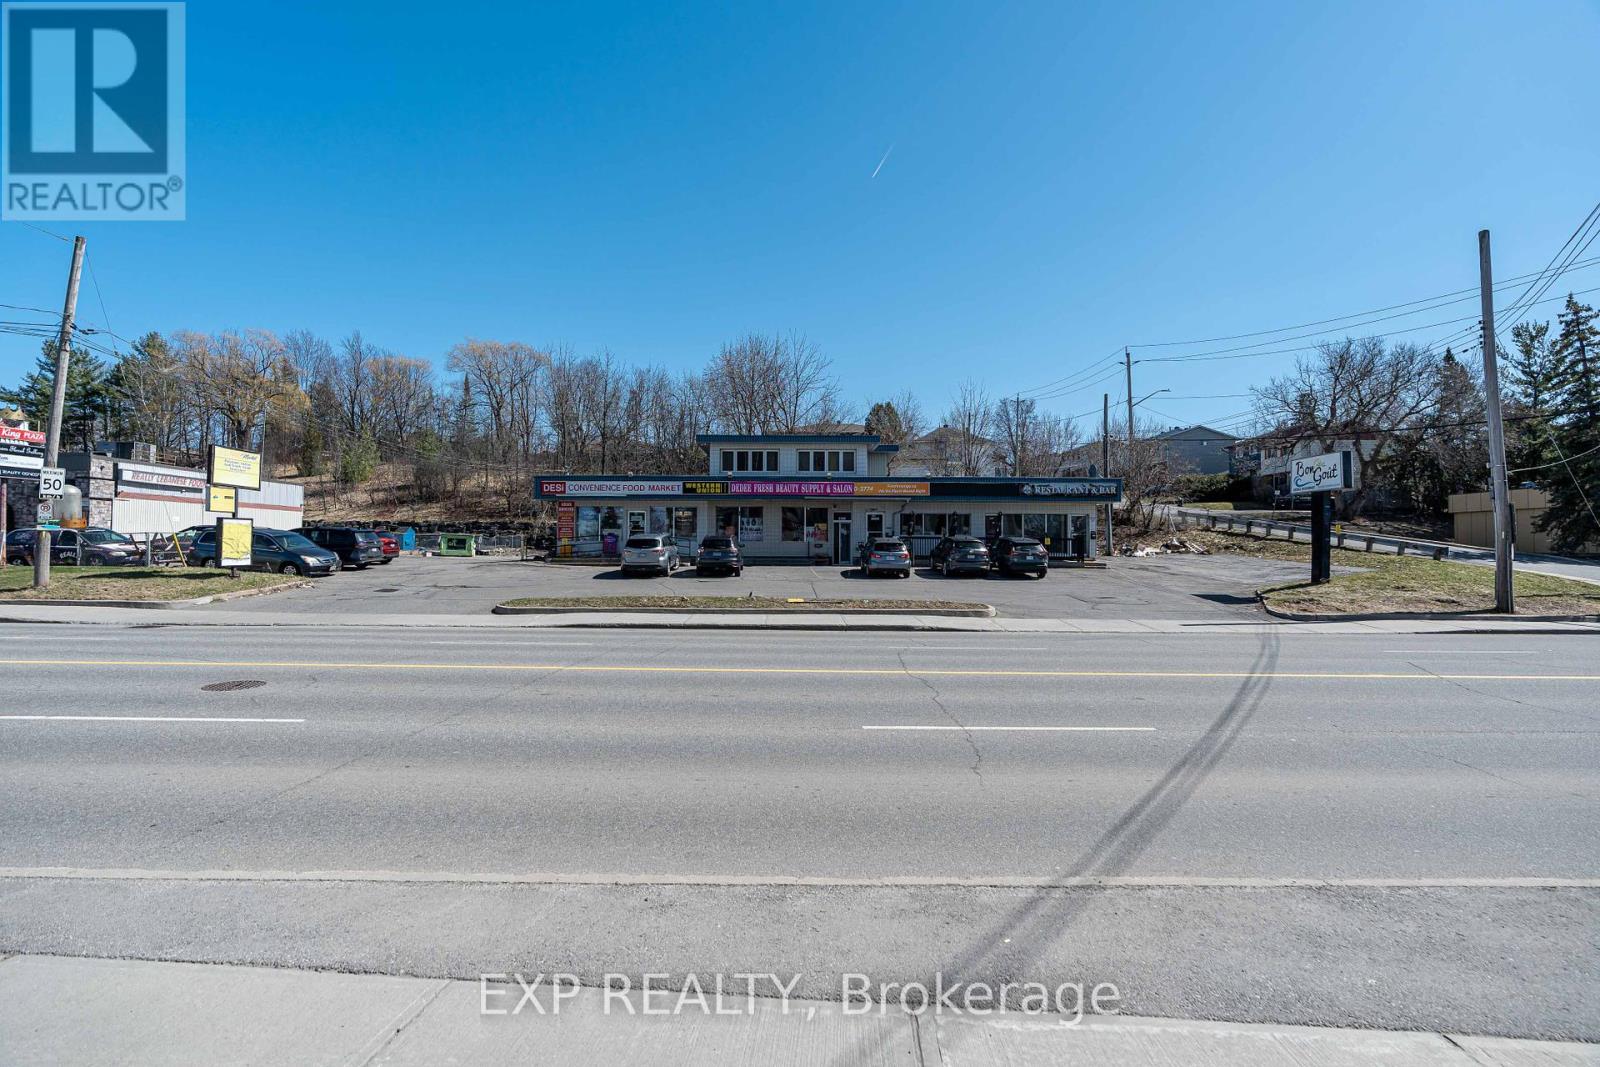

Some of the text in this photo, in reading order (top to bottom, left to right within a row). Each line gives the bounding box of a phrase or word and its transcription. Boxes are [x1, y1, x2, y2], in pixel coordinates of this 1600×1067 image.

[1, 428, 44, 441] King PLAZA
[43, 478, 62, 491] 50
[543, 484, 682, 492] DESI CONVENIENCE FOOD MARKET
[753, 483, 774, 493] FRESH
[775, 483, 799, 493] BEAUTY
[801, 483, 824, 493] SUPPLY
[833, 483, 853, 493] SALON
[1034, 486, 1089, 495] RESTAURANT
[1099, 486, 1116, 495] BAR
